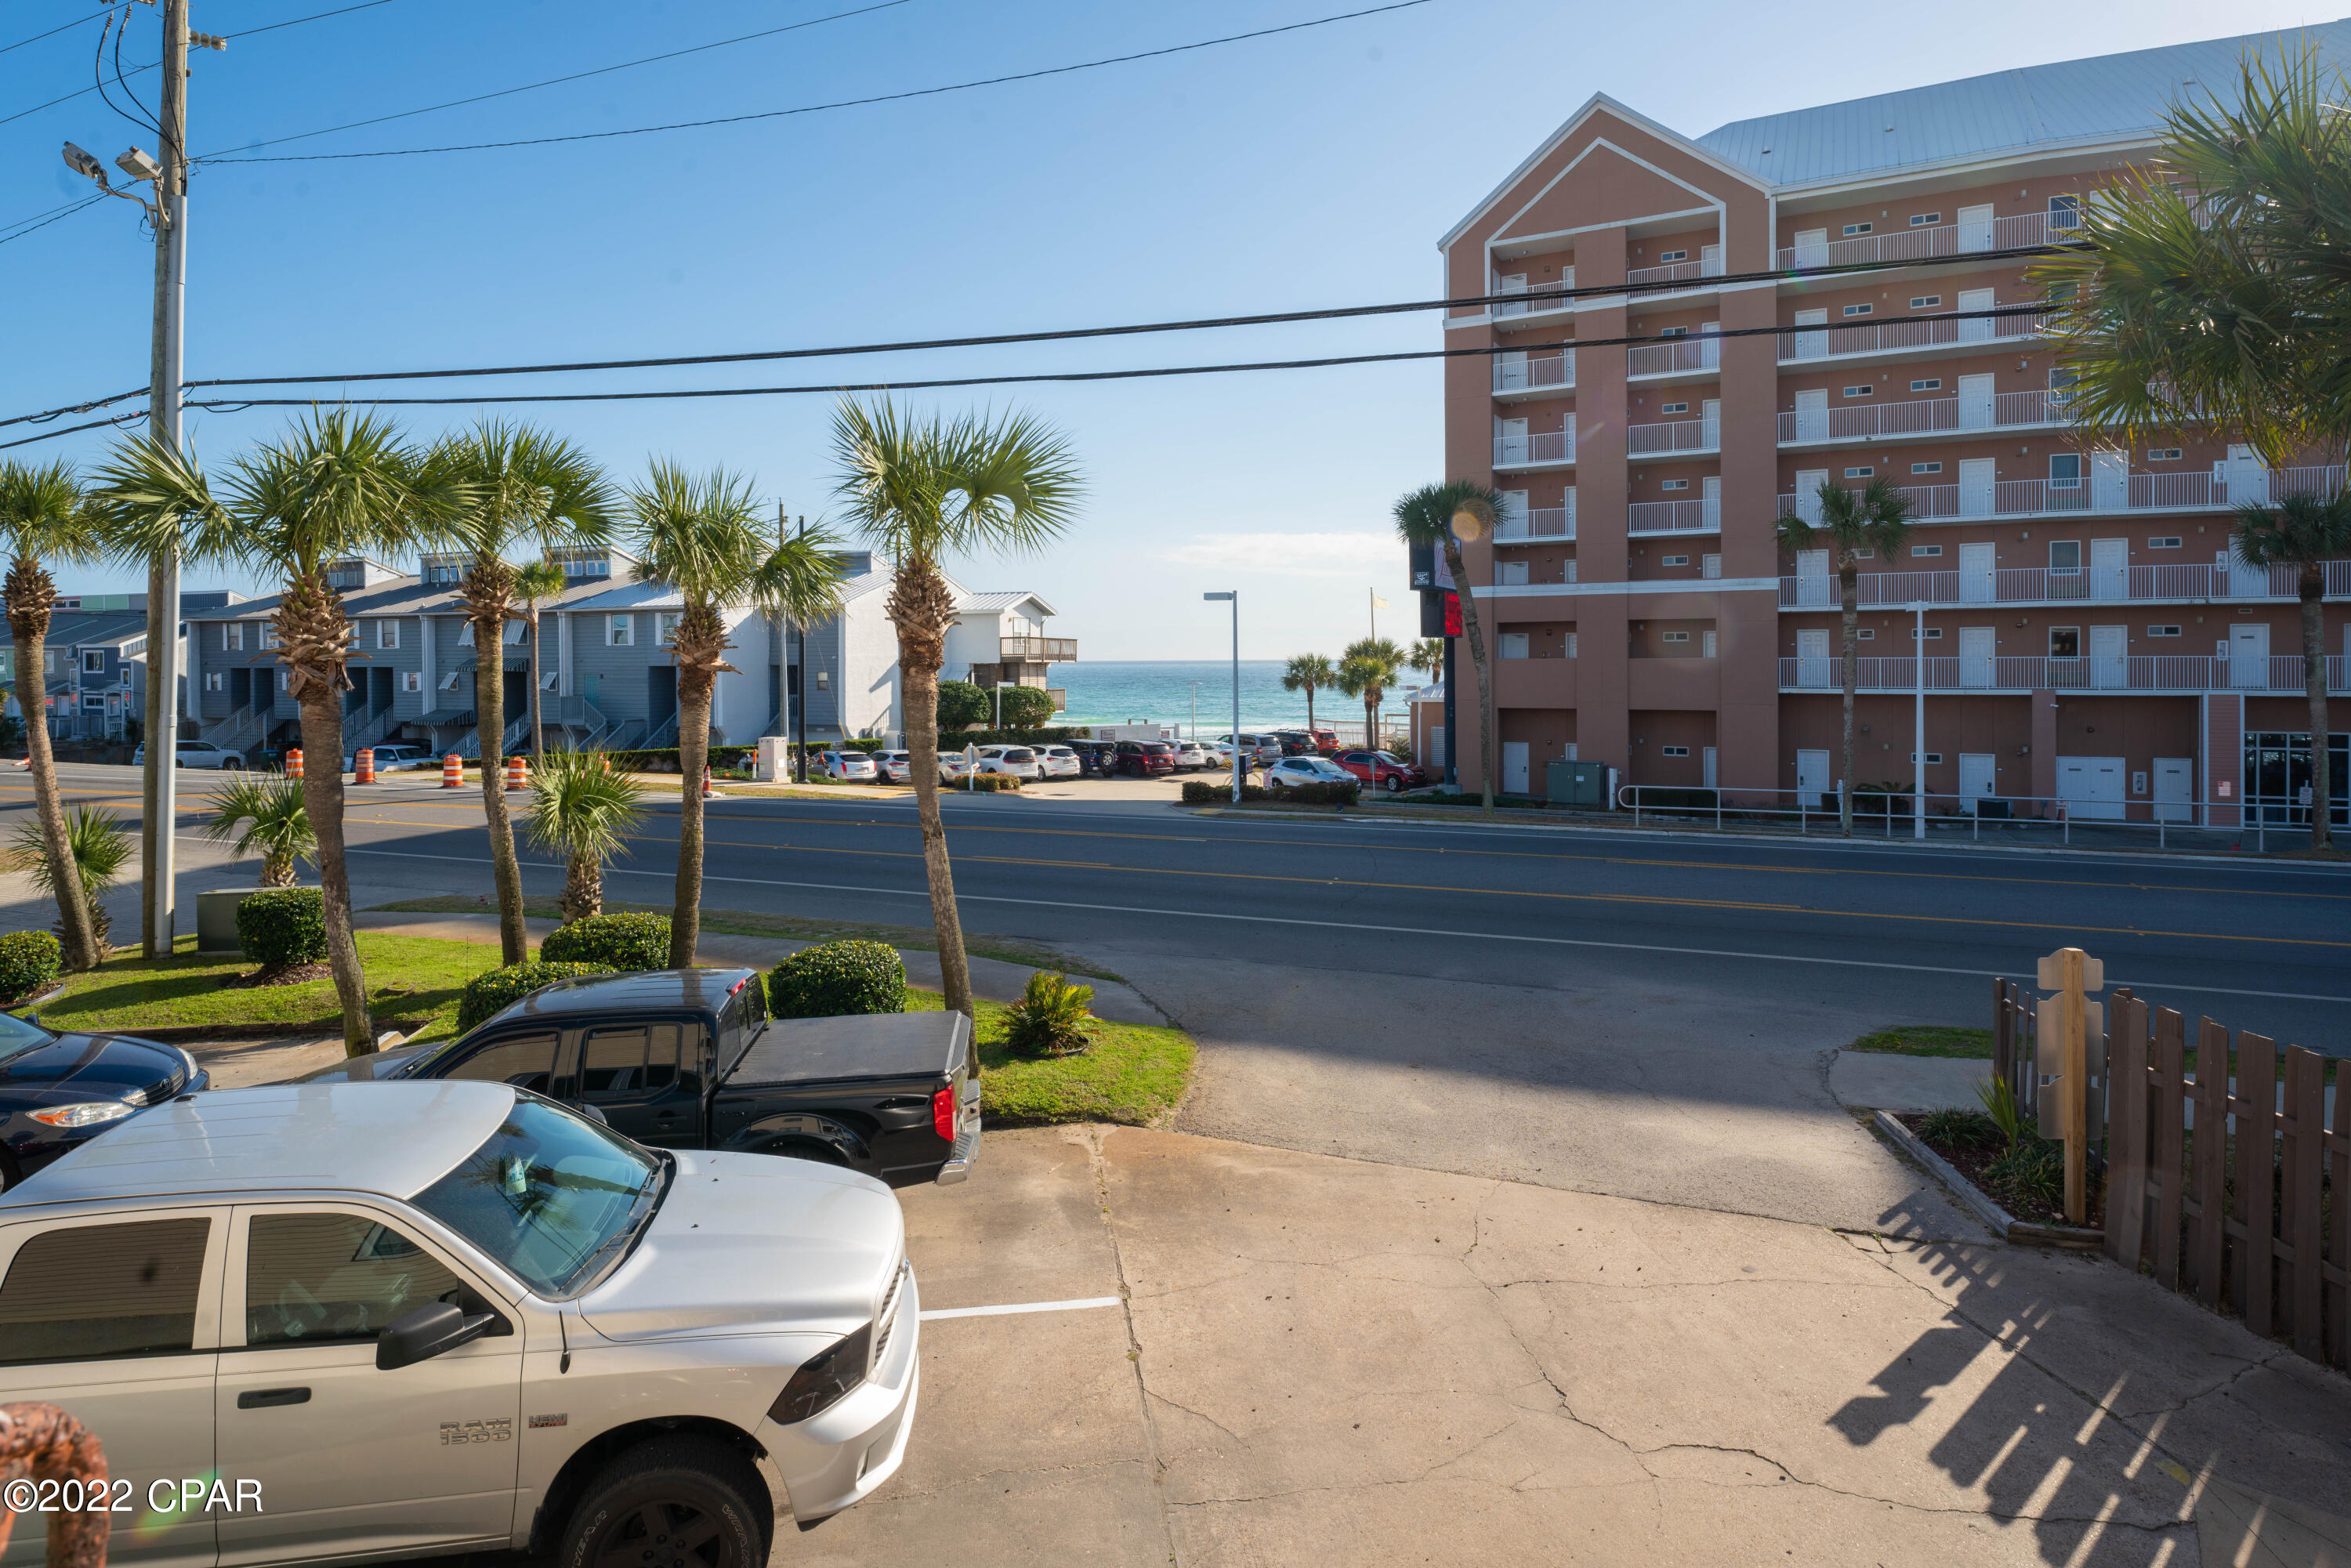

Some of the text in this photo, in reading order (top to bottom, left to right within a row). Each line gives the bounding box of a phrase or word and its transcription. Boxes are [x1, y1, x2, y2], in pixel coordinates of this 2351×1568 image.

[440, 1418, 512, 1433] RAM
[528, 1414, 567, 1425] HEMI
[440, 1429, 512, 1446] 1500
